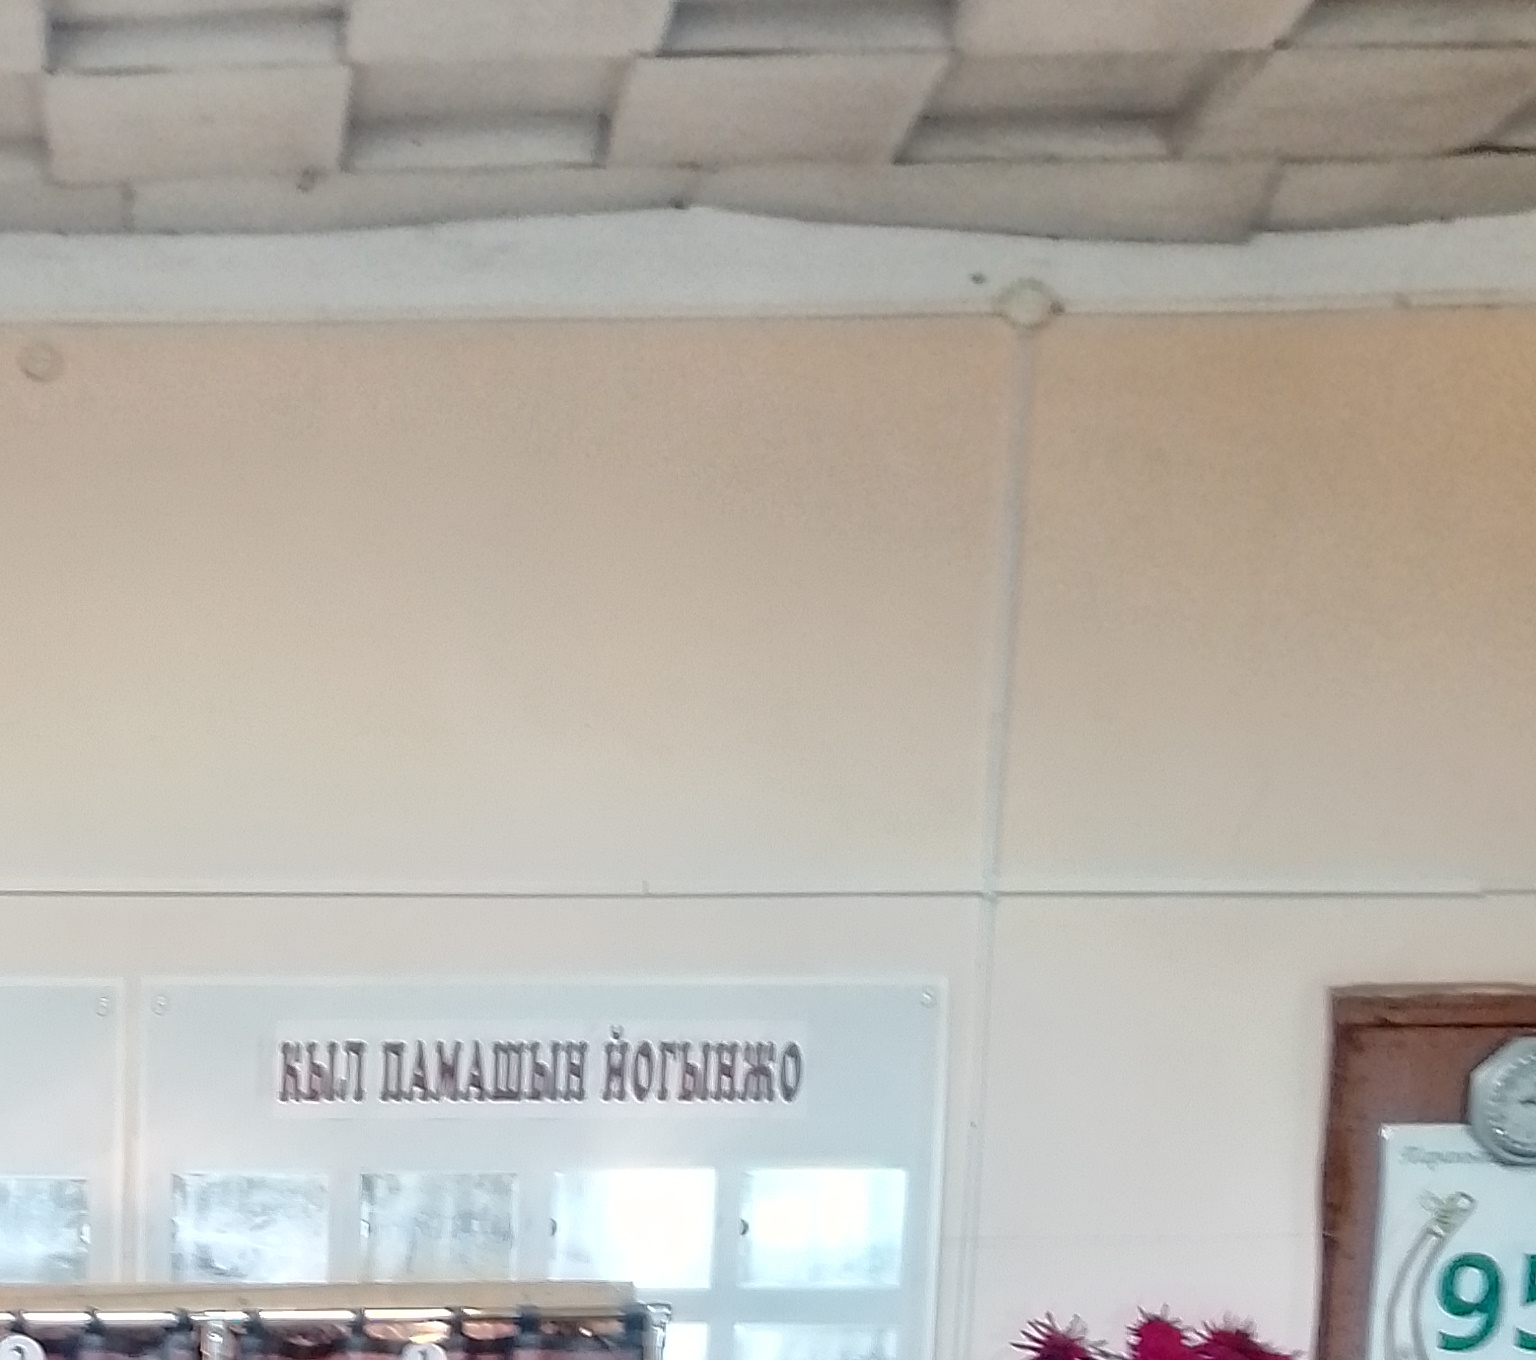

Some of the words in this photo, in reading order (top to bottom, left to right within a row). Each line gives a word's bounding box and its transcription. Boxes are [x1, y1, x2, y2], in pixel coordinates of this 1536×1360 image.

[278, 1040, 366, 1101] КЫЛ
[380, 1040, 588, 1101] ПАМАШЫН
[602, 1025, 803, 1102] ЙОГЫНЖО
